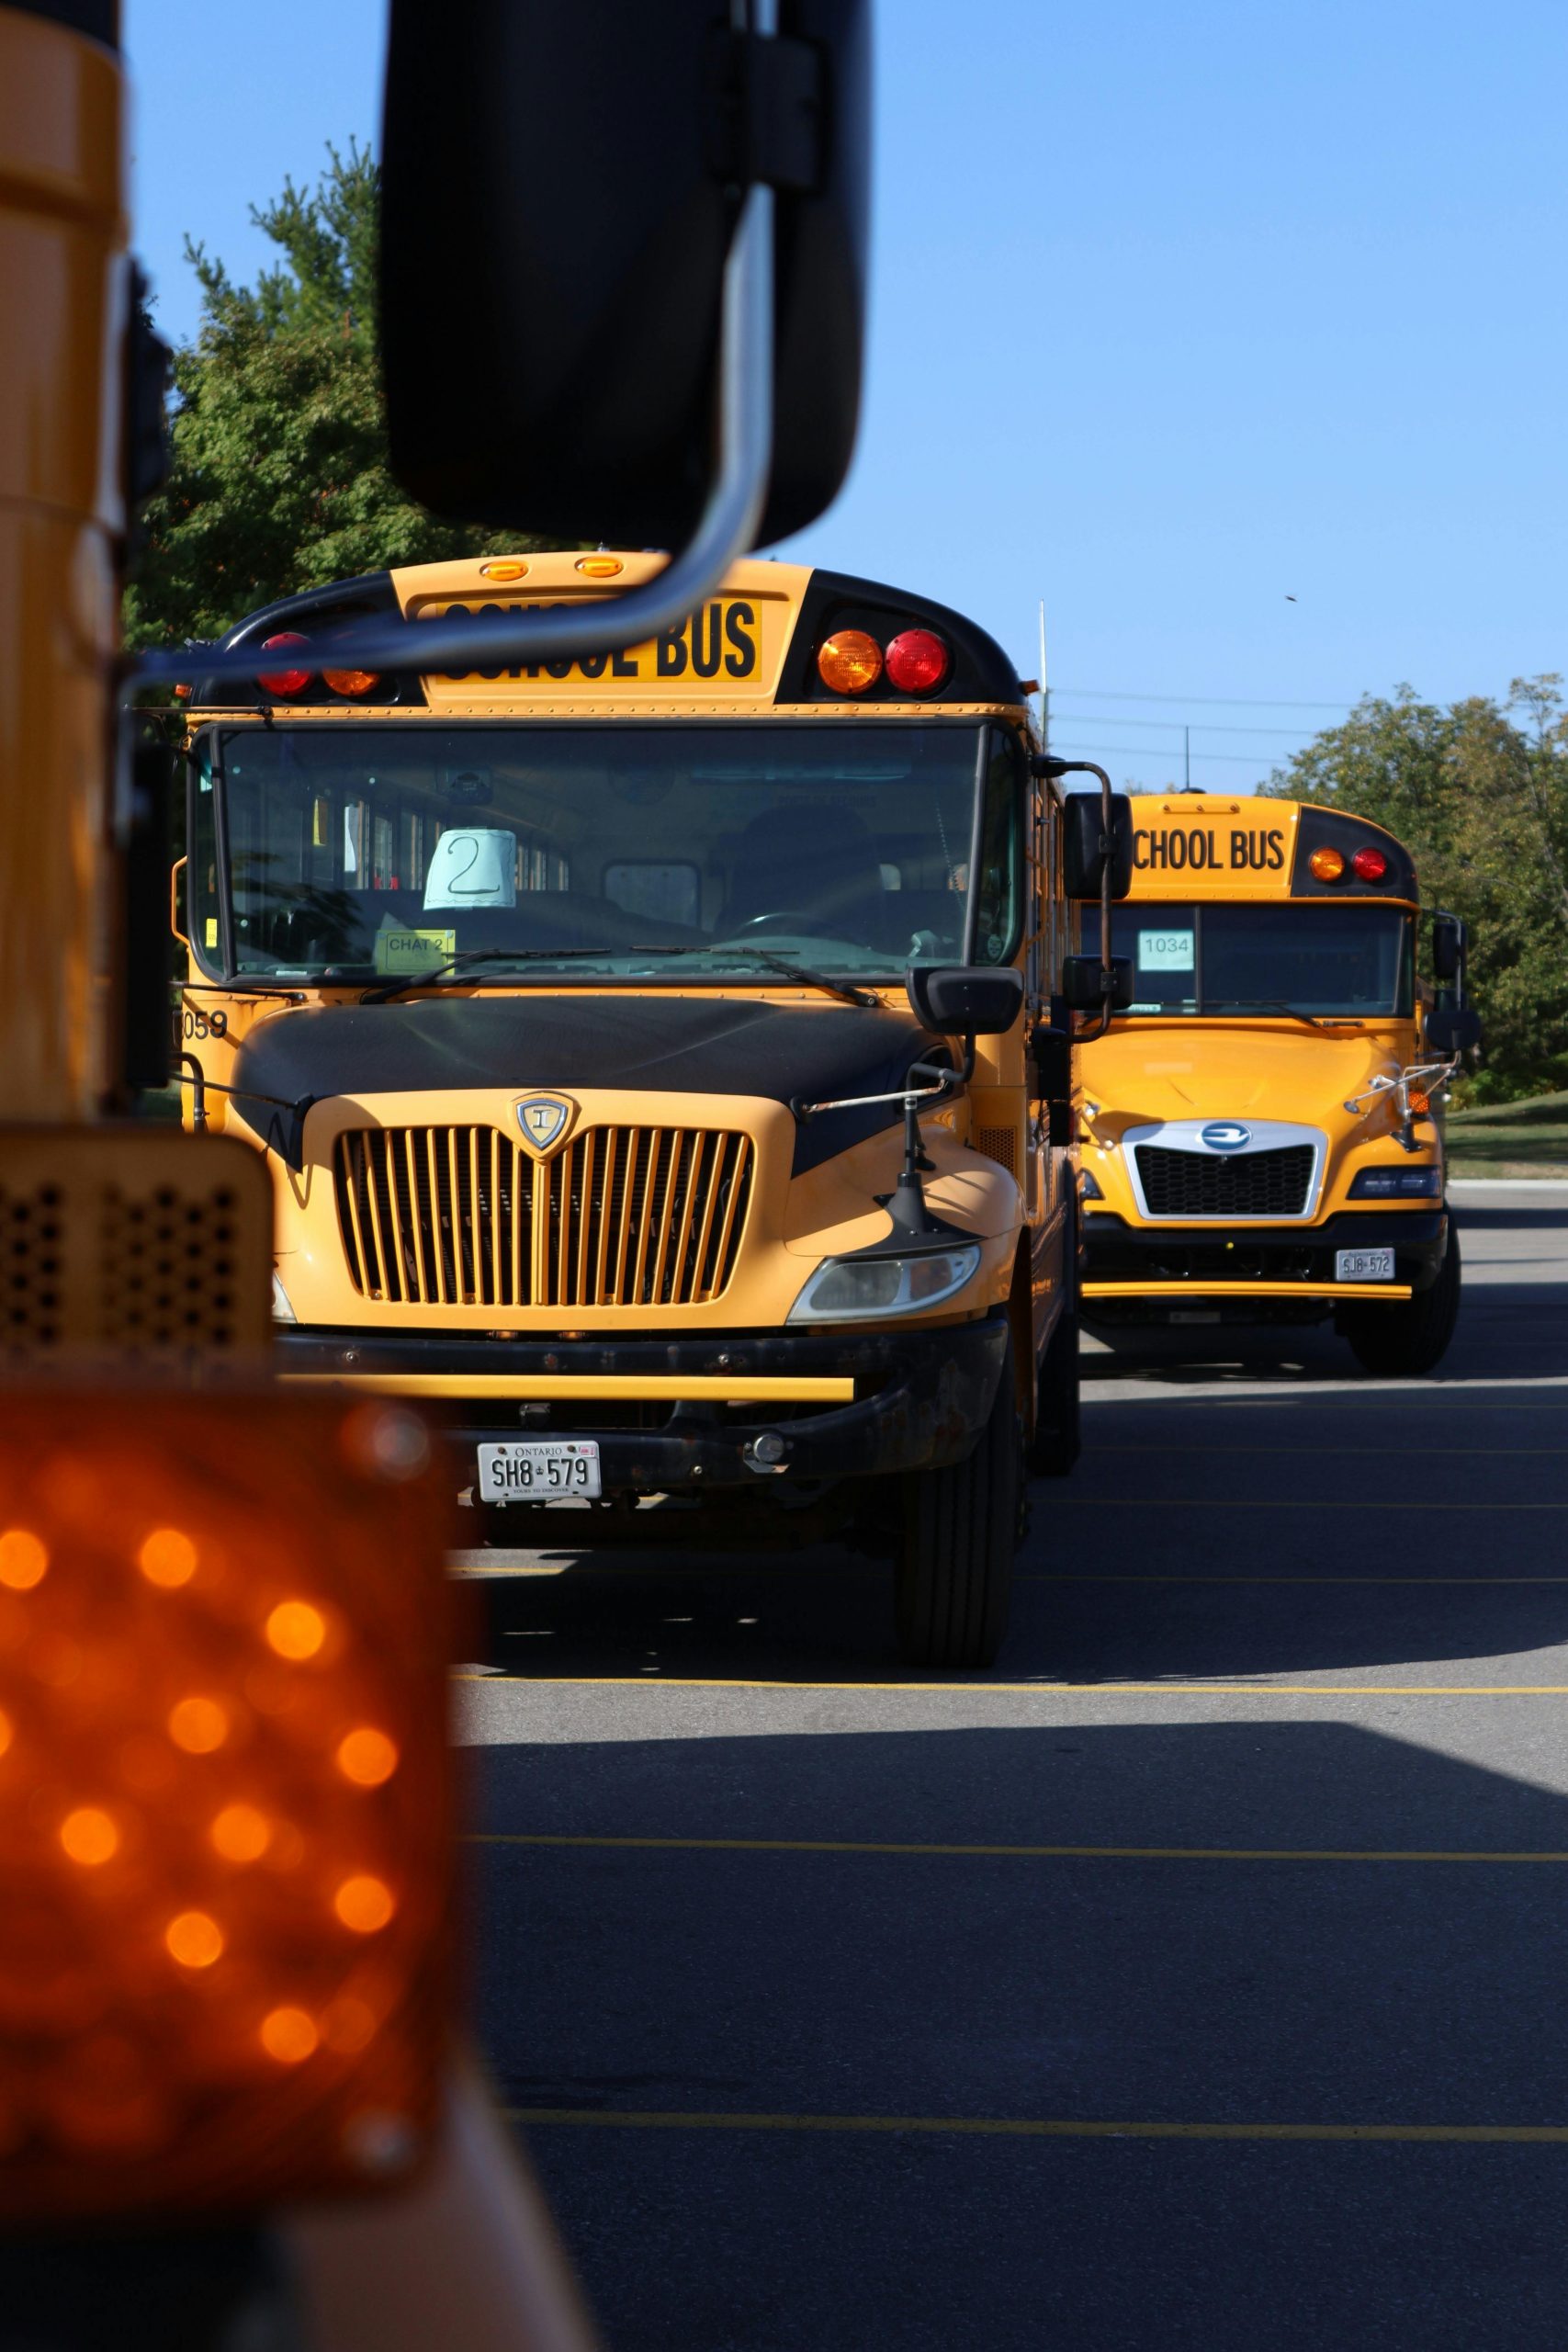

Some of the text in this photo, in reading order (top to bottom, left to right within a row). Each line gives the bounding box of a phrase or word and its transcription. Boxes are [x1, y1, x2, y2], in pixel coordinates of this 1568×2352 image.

[657, 601, 756, 678] BUS
[1133, 829, 1285, 870] CHOOL BUS
[447, 836, 501, 895] 2
[389, 938, 443, 951] CHAT 2
[1145, 937, 1189, 953] 1034
[182, 1010, 228, 1040] 059
[514, 1447, 563, 1458] ONTARIO
